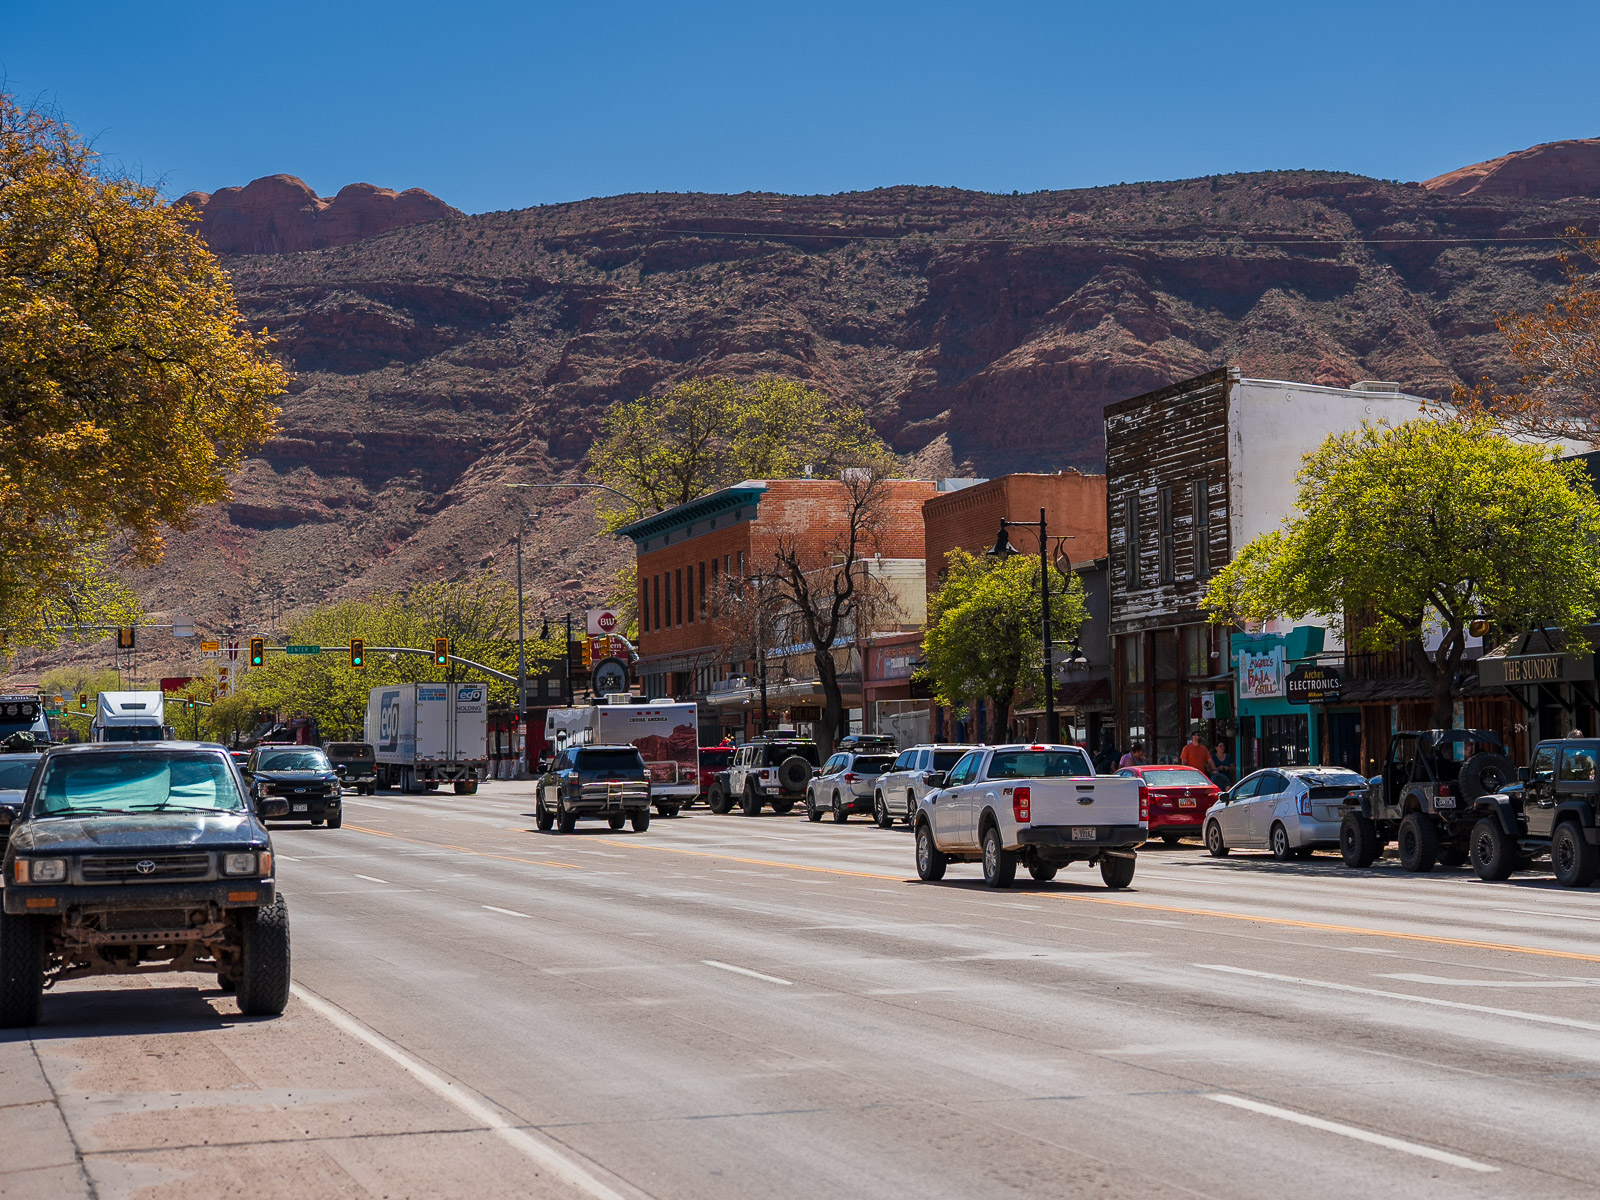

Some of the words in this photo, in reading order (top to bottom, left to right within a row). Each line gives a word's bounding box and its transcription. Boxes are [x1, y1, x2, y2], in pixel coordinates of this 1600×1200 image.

[600, 618, 615, 626] BW
[1303, 669, 1325, 679] Arches
[1504, 661, 1520, 681] THE
[1522, 658, 1559, 680] SUNDRY
[1254, 683, 1277, 695] GRILL
[1289, 678, 1339, 691] ELECTRONICS
